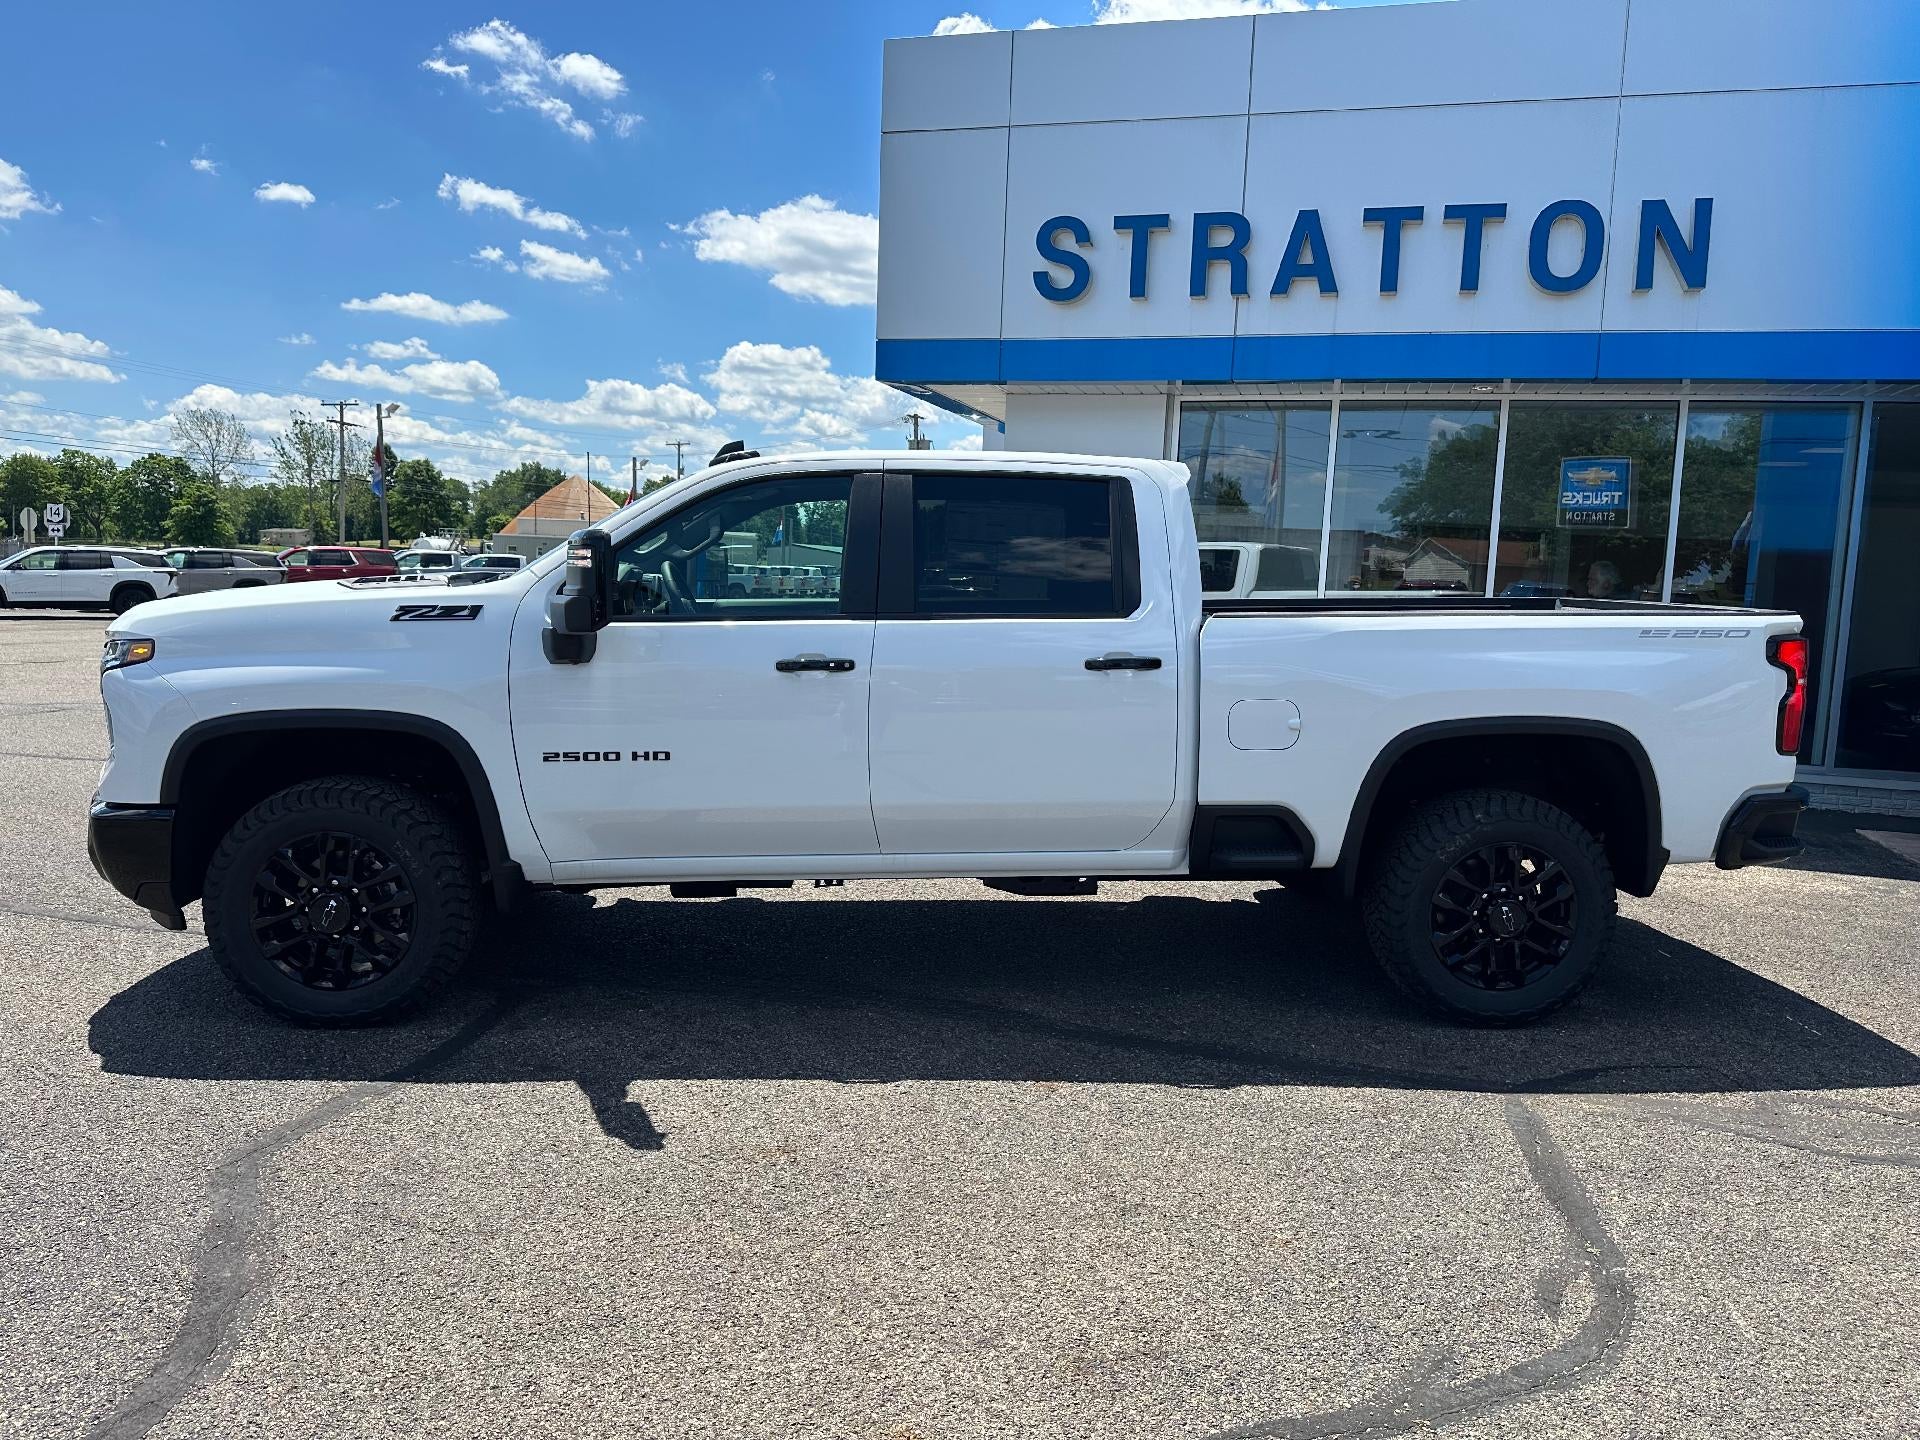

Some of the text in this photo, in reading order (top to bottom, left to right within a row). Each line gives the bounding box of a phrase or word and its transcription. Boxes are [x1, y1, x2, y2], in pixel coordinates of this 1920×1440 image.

[1033, 198, 1713, 303] STRATTON
[50, 506, 61, 518] 14
[389, 604, 484, 621] Z71
[542, 751, 671, 762] 2500 HD
